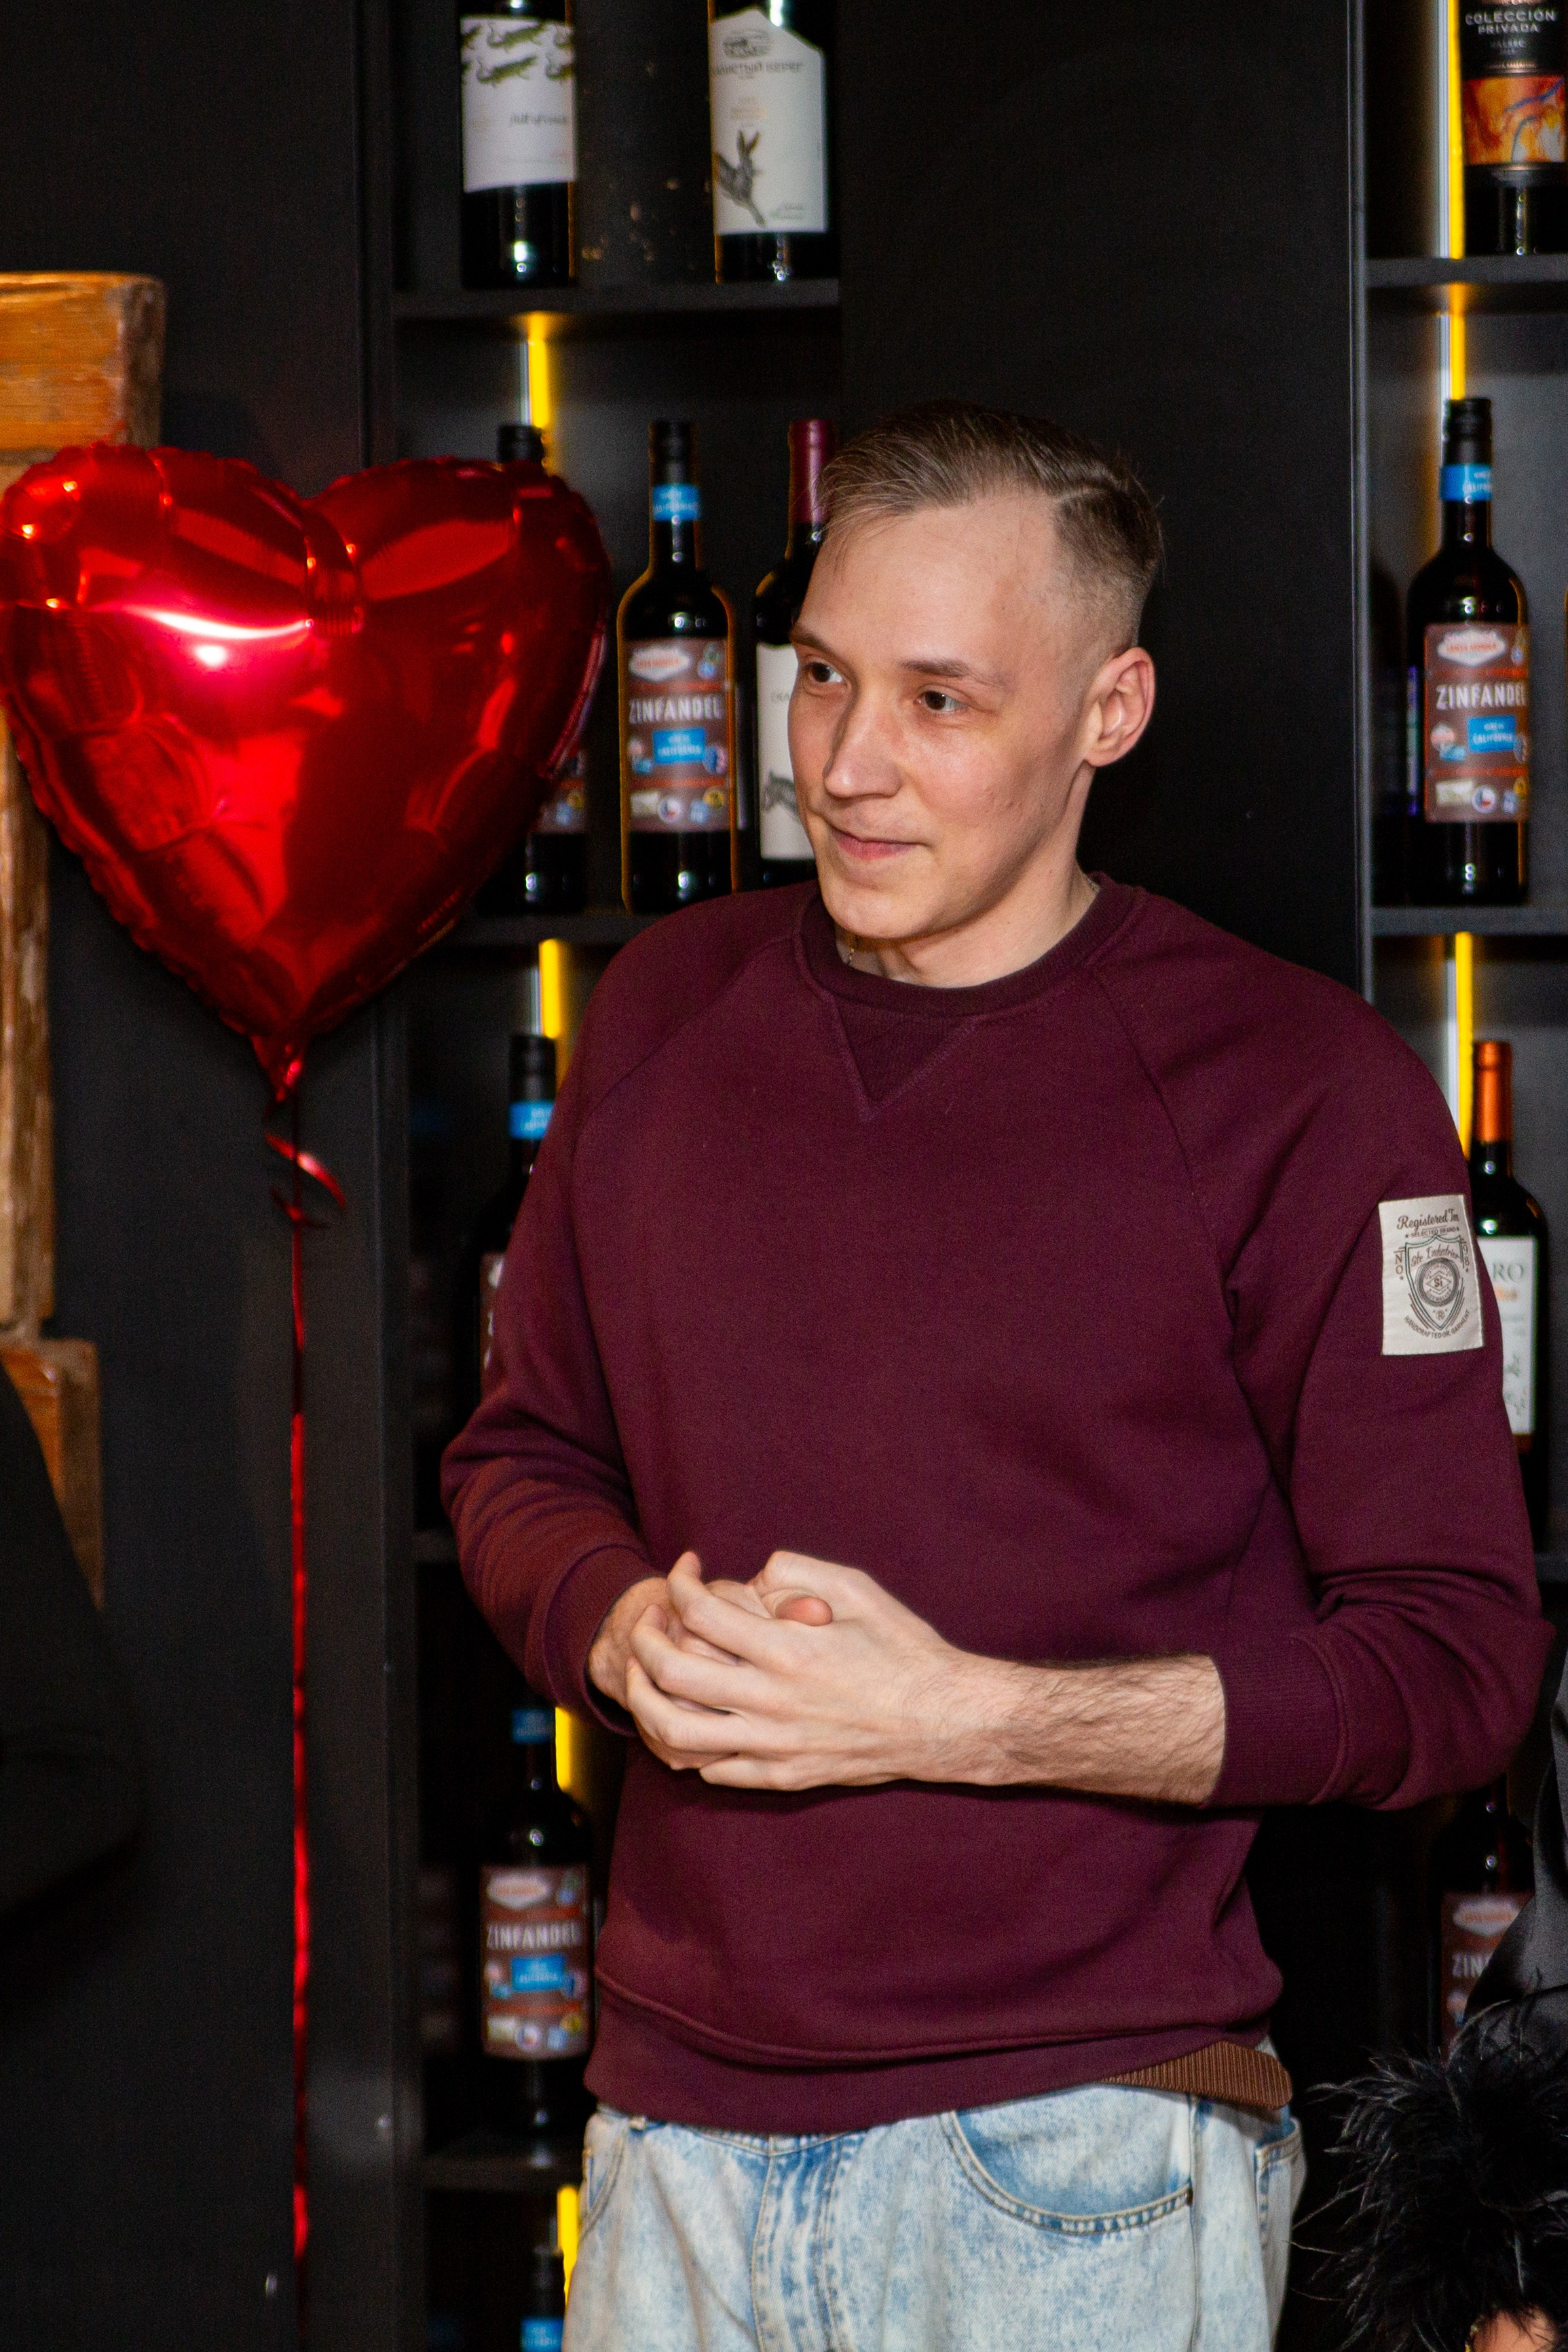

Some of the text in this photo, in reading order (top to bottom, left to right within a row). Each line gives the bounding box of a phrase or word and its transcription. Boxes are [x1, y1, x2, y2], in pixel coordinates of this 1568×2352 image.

[1465, 7, 1557, 26] COLECCIÓN
[1478, 22, 1541, 35] PRIVADA
[629, 695, 722, 724] ZINFANDEL
[1396, 1209, 1448, 1230] Registered
[1434, 1275, 1443, 1288] Si
[1493, 1262, 1525, 1282] RO
[1404, 1315, 1442, 1339] HANDCRAFTED
[1451, 1309, 1470, 1334] GARMENT
[486, 1922, 582, 1950] ZINFANDEL
